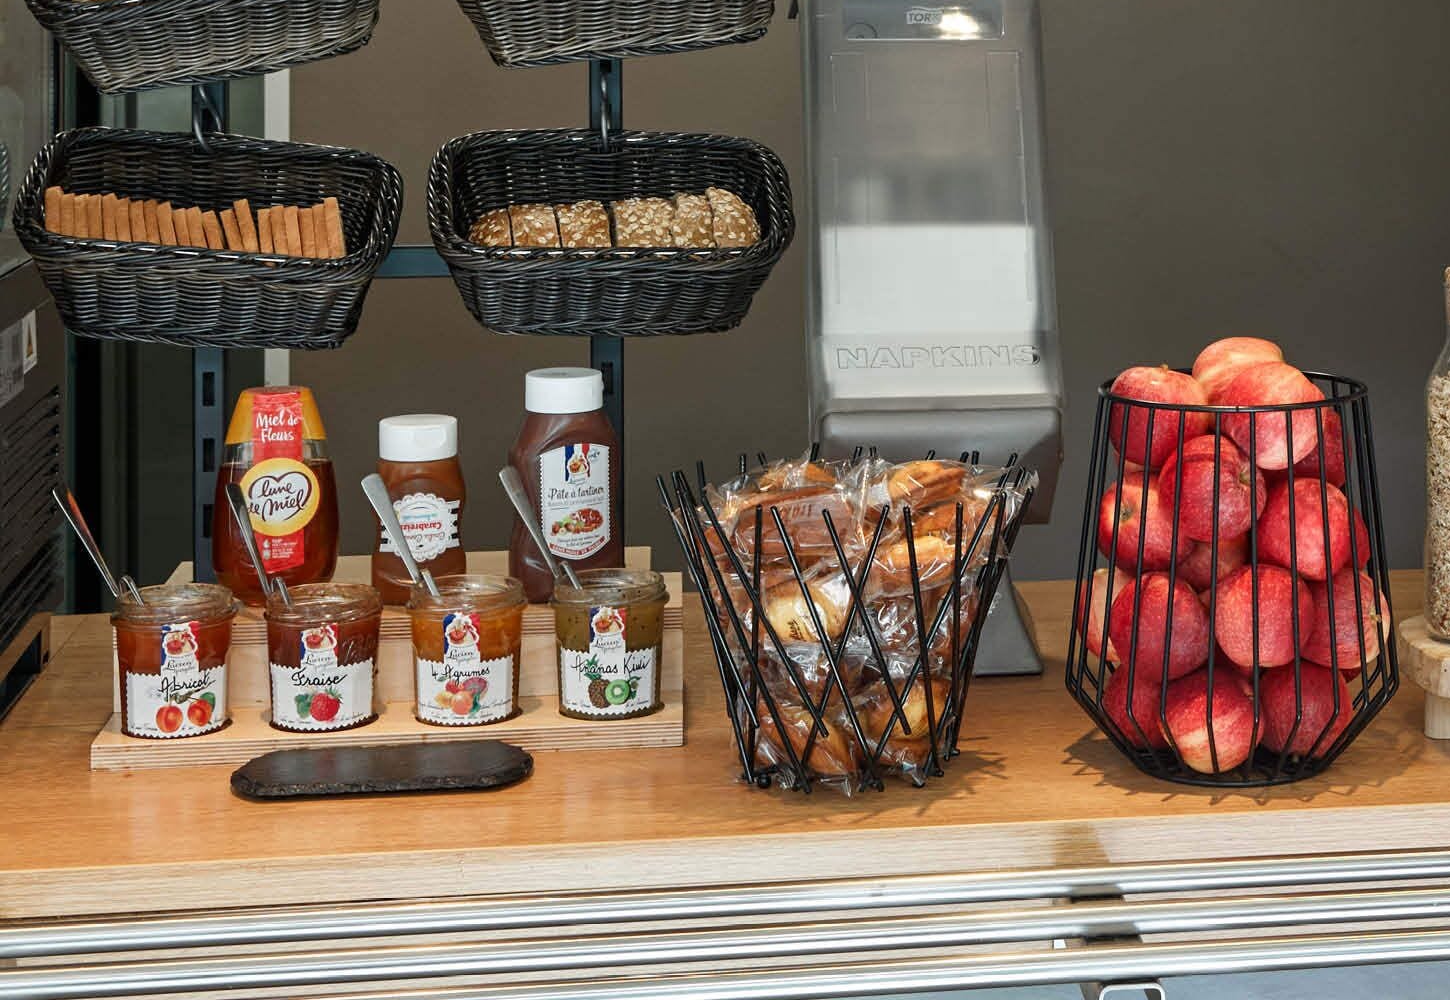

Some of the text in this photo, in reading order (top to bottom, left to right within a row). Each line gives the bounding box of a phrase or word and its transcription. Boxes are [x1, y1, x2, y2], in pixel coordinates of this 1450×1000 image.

[836, 345, 1041, 369] NAPKINS
[256, 409, 285, 428] Miel
[261, 427, 295, 444] Fleurs
[291, 667, 348, 687] Fraise
[444, 663, 490, 687] Agrumes
[623, 653, 651, 678] Kiwi
[158, 672, 217, 702] Abricot
